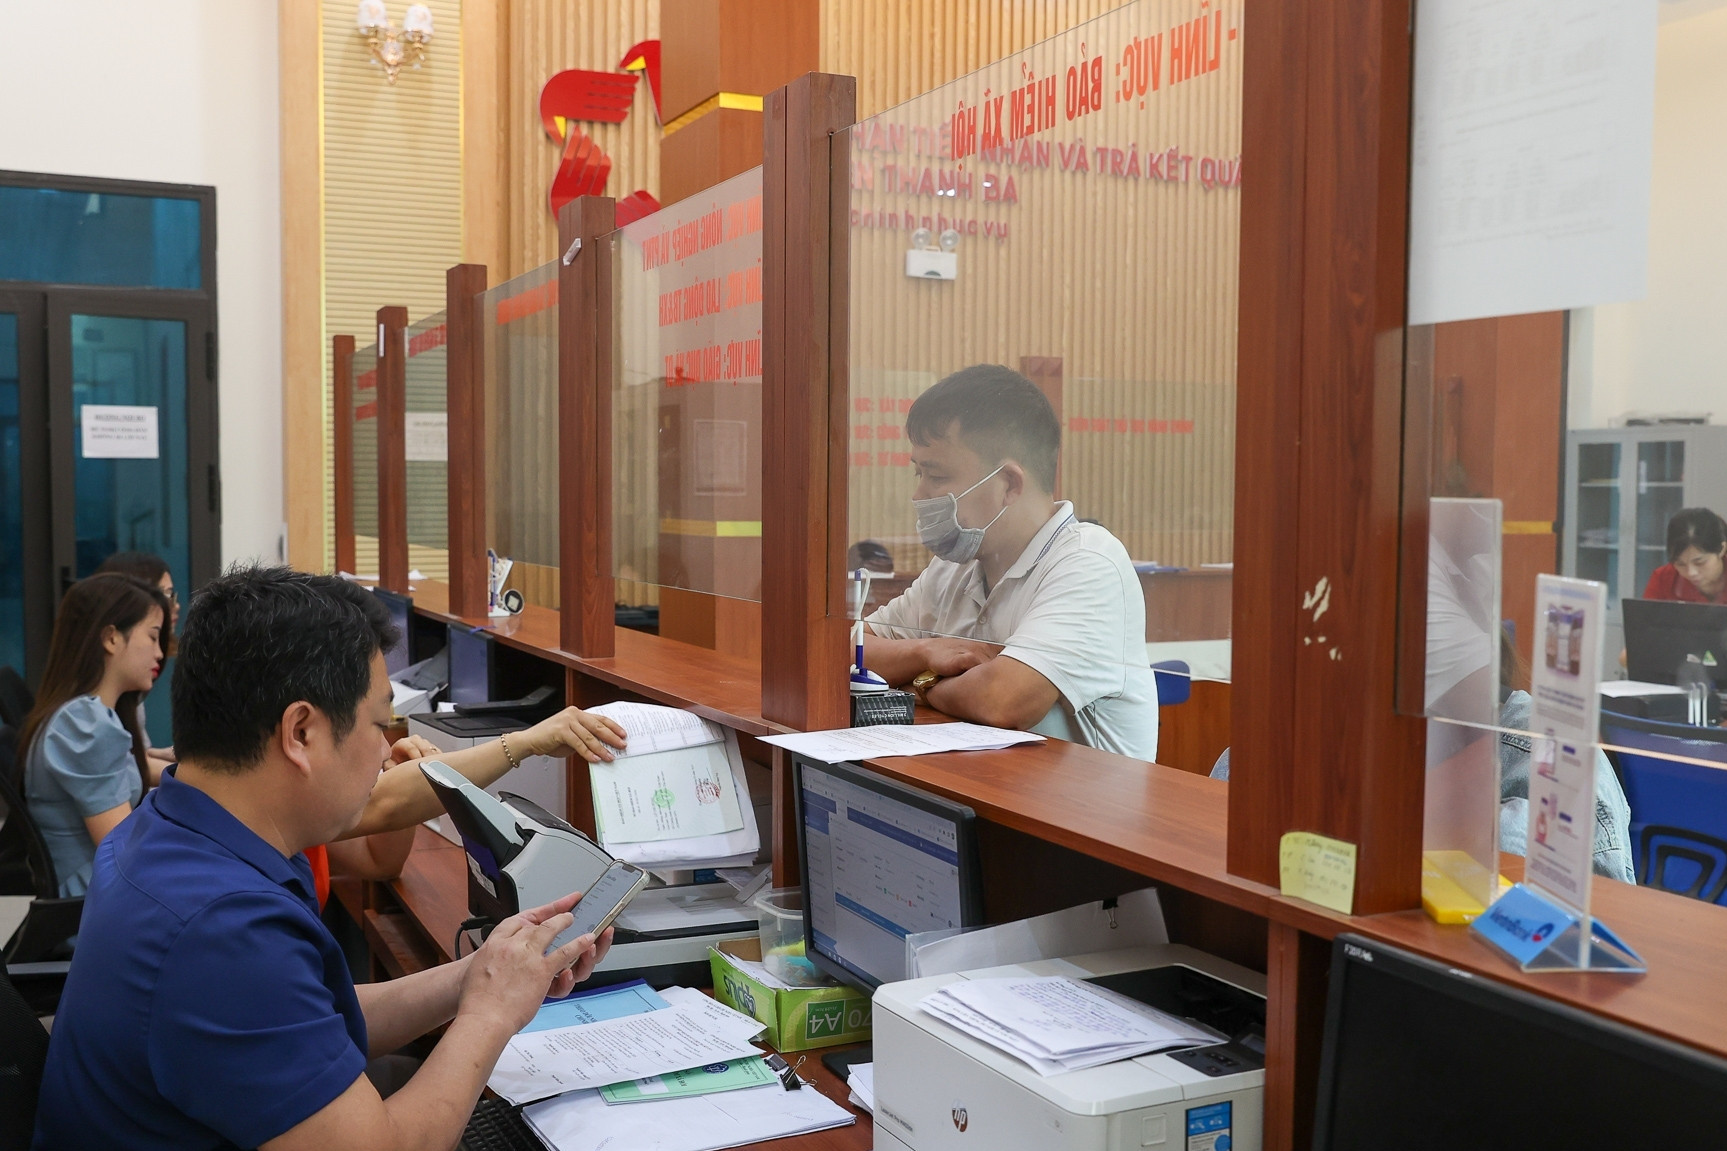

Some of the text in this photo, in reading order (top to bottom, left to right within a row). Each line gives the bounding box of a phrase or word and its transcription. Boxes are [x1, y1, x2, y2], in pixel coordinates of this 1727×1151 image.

[1058, 138, 1089, 173] VÀ
[1094, 142, 1140, 178] TRẢ
[1146, 145, 1193, 182] KẾT
[885, 164, 973, 199] THANH
[809, 1011, 842, 1034] A4
[951, 1107, 968, 1132] hp
